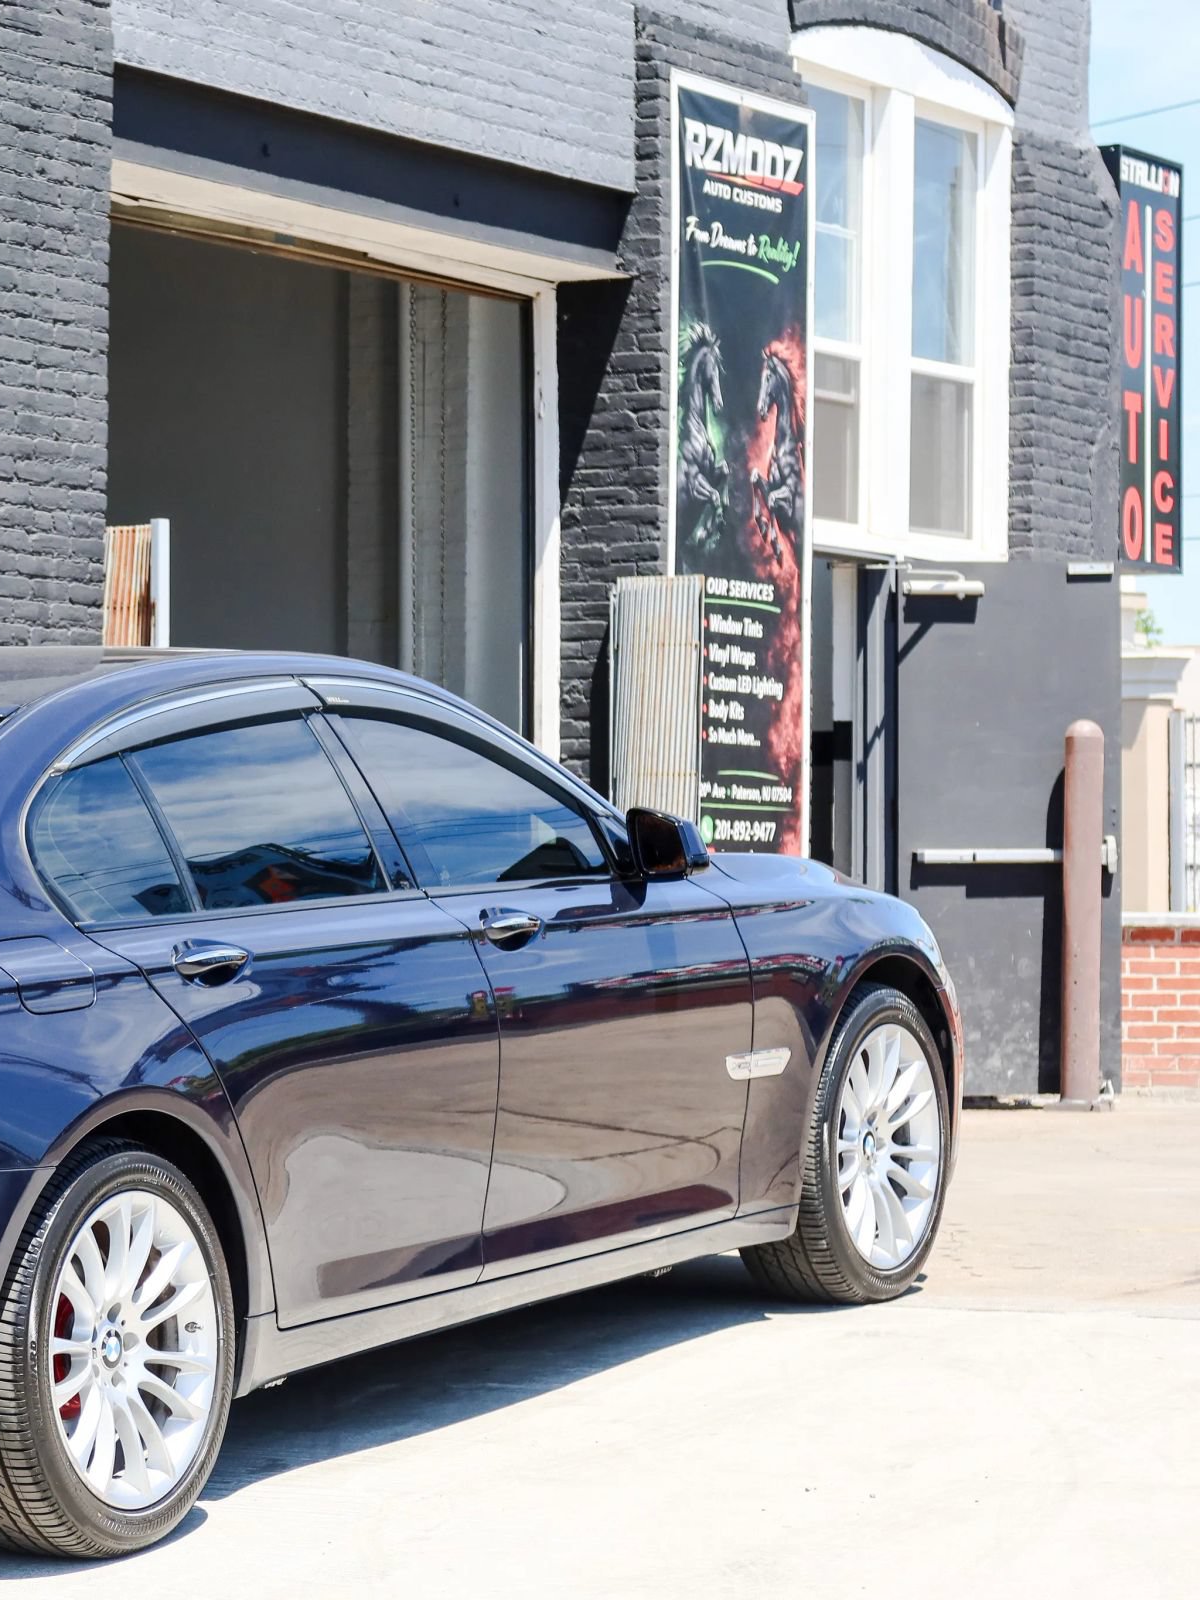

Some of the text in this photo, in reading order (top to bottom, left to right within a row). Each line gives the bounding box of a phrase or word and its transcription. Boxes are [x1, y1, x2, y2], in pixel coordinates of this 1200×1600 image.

[684, 117, 804, 192] RZMODZ
[1120, 155, 1180, 198] STALLION
[703, 179, 783, 213] AUTO CUSTOMS
[686, 215, 800, 272] From Dreams to Reality!
[1123, 199, 1143, 561] AUTO
[1152, 209, 1176, 566] SERVICE
[706, 576, 774, 602] OUR SERVICES
[709, 613, 763, 638] Window Tints
[708, 643, 756, 670] Vinyl Wraps
[708, 672, 784, 701] Custom LED Lighting
[708, 699, 745, 723] Body Kits
[708, 726, 717, 743] So
[717, 727, 737, 745] Much
[712, 782, 726, 799] Ave
[761, 785, 771, 802] NJ
[771, 786, 793, 802] 07504
[714, 819, 777, 842] 201-892-9477
